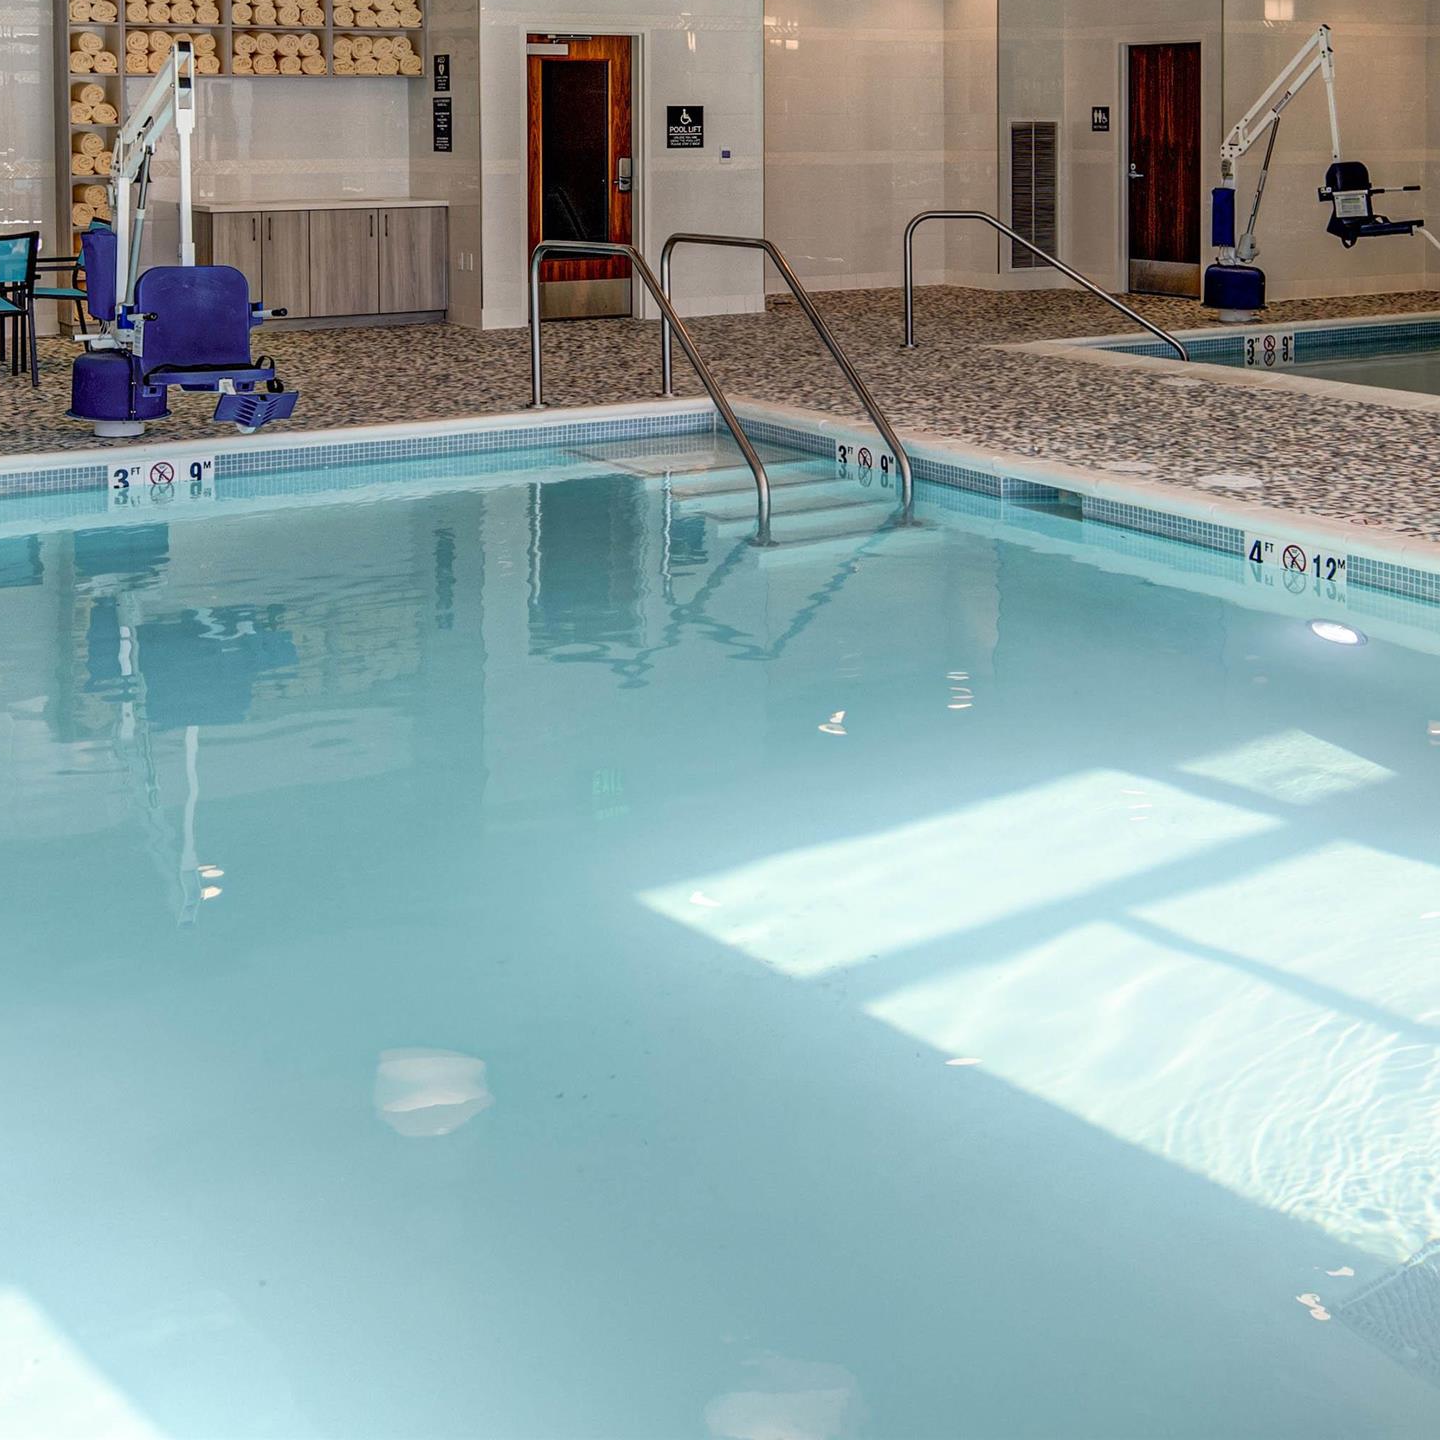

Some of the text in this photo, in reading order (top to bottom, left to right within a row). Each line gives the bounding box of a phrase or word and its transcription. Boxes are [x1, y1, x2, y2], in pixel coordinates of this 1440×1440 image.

[838, 445, 847, 463] 3
[847, 447, 854, 455] FT
[114, 469, 129, 489] 3
[131, 467, 141, 475] FT
[203, 461, 211, 469] M
[1249, 540, 1264, 563] 4
[1265, 542, 1274, 553] FT
[1337, 559, 1346, 569] M
